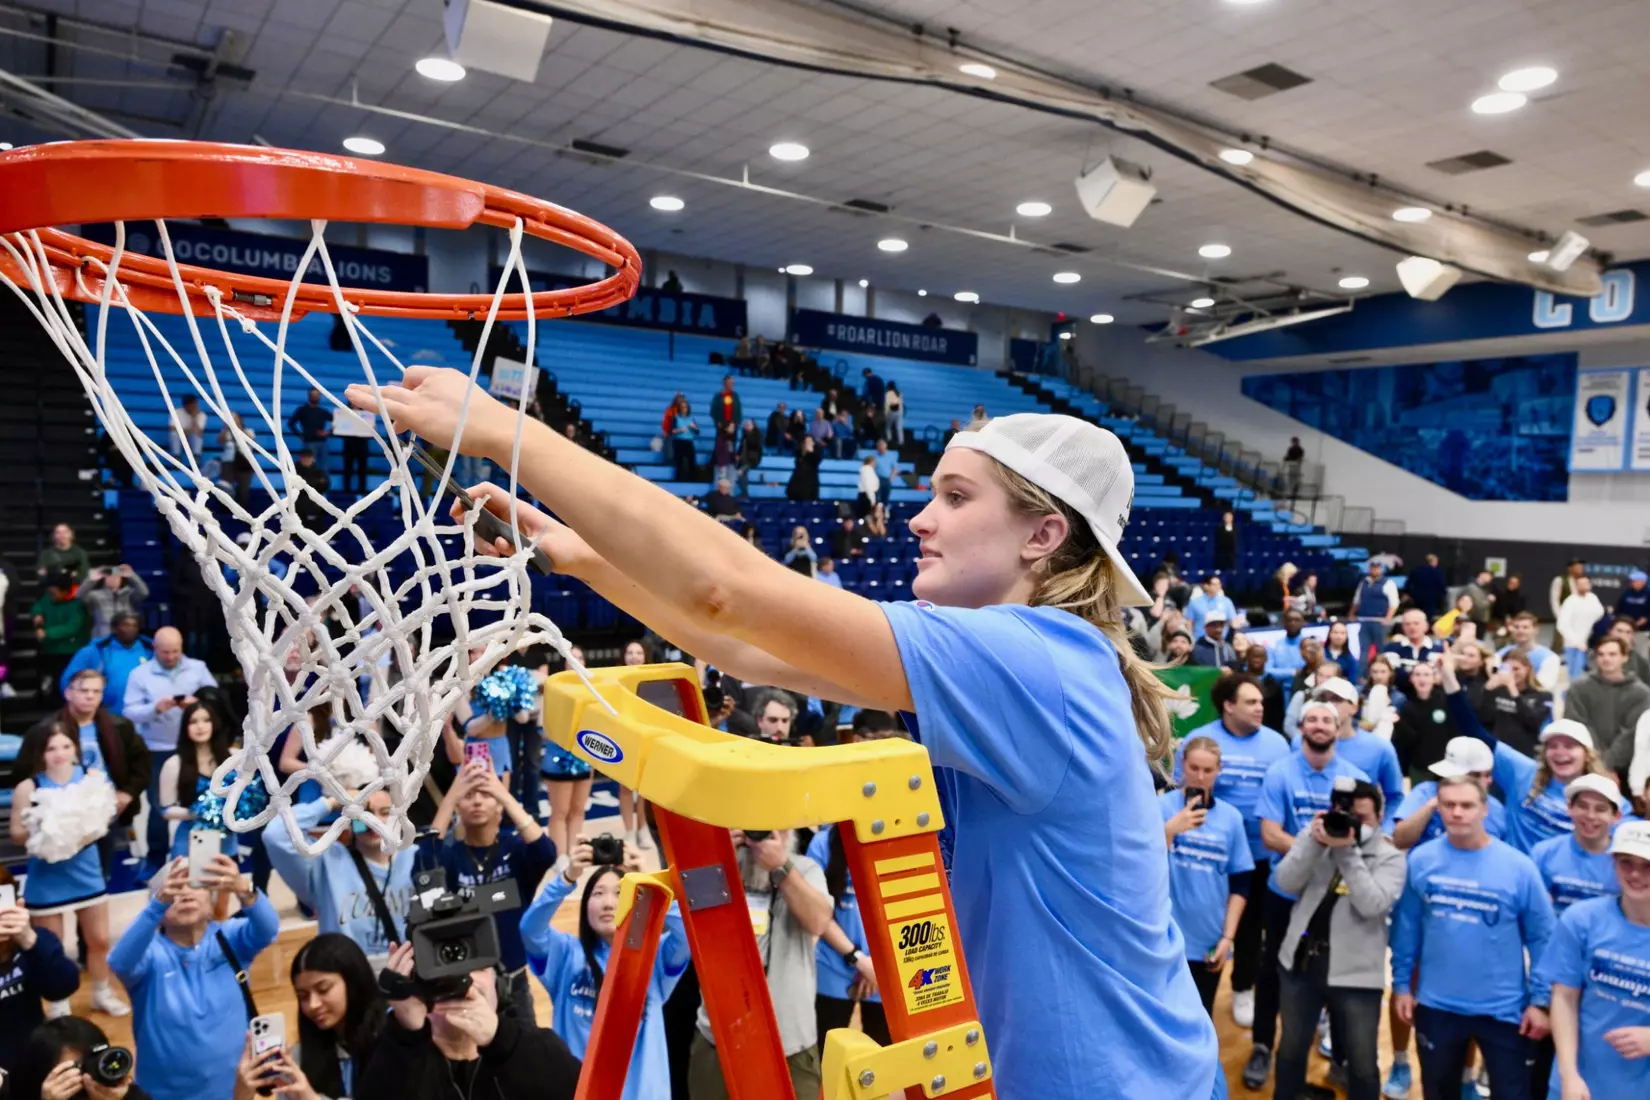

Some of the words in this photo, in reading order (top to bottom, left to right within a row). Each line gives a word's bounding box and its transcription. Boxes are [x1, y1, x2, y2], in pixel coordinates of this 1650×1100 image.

[827, 324, 948, 354] #ROARLIONROAR
[584, 735, 615, 758] WERNER
[904, 946, 918, 956] LOAD
[918, 942, 942, 954] CAPACITY
[933, 964, 951, 975] WORK
